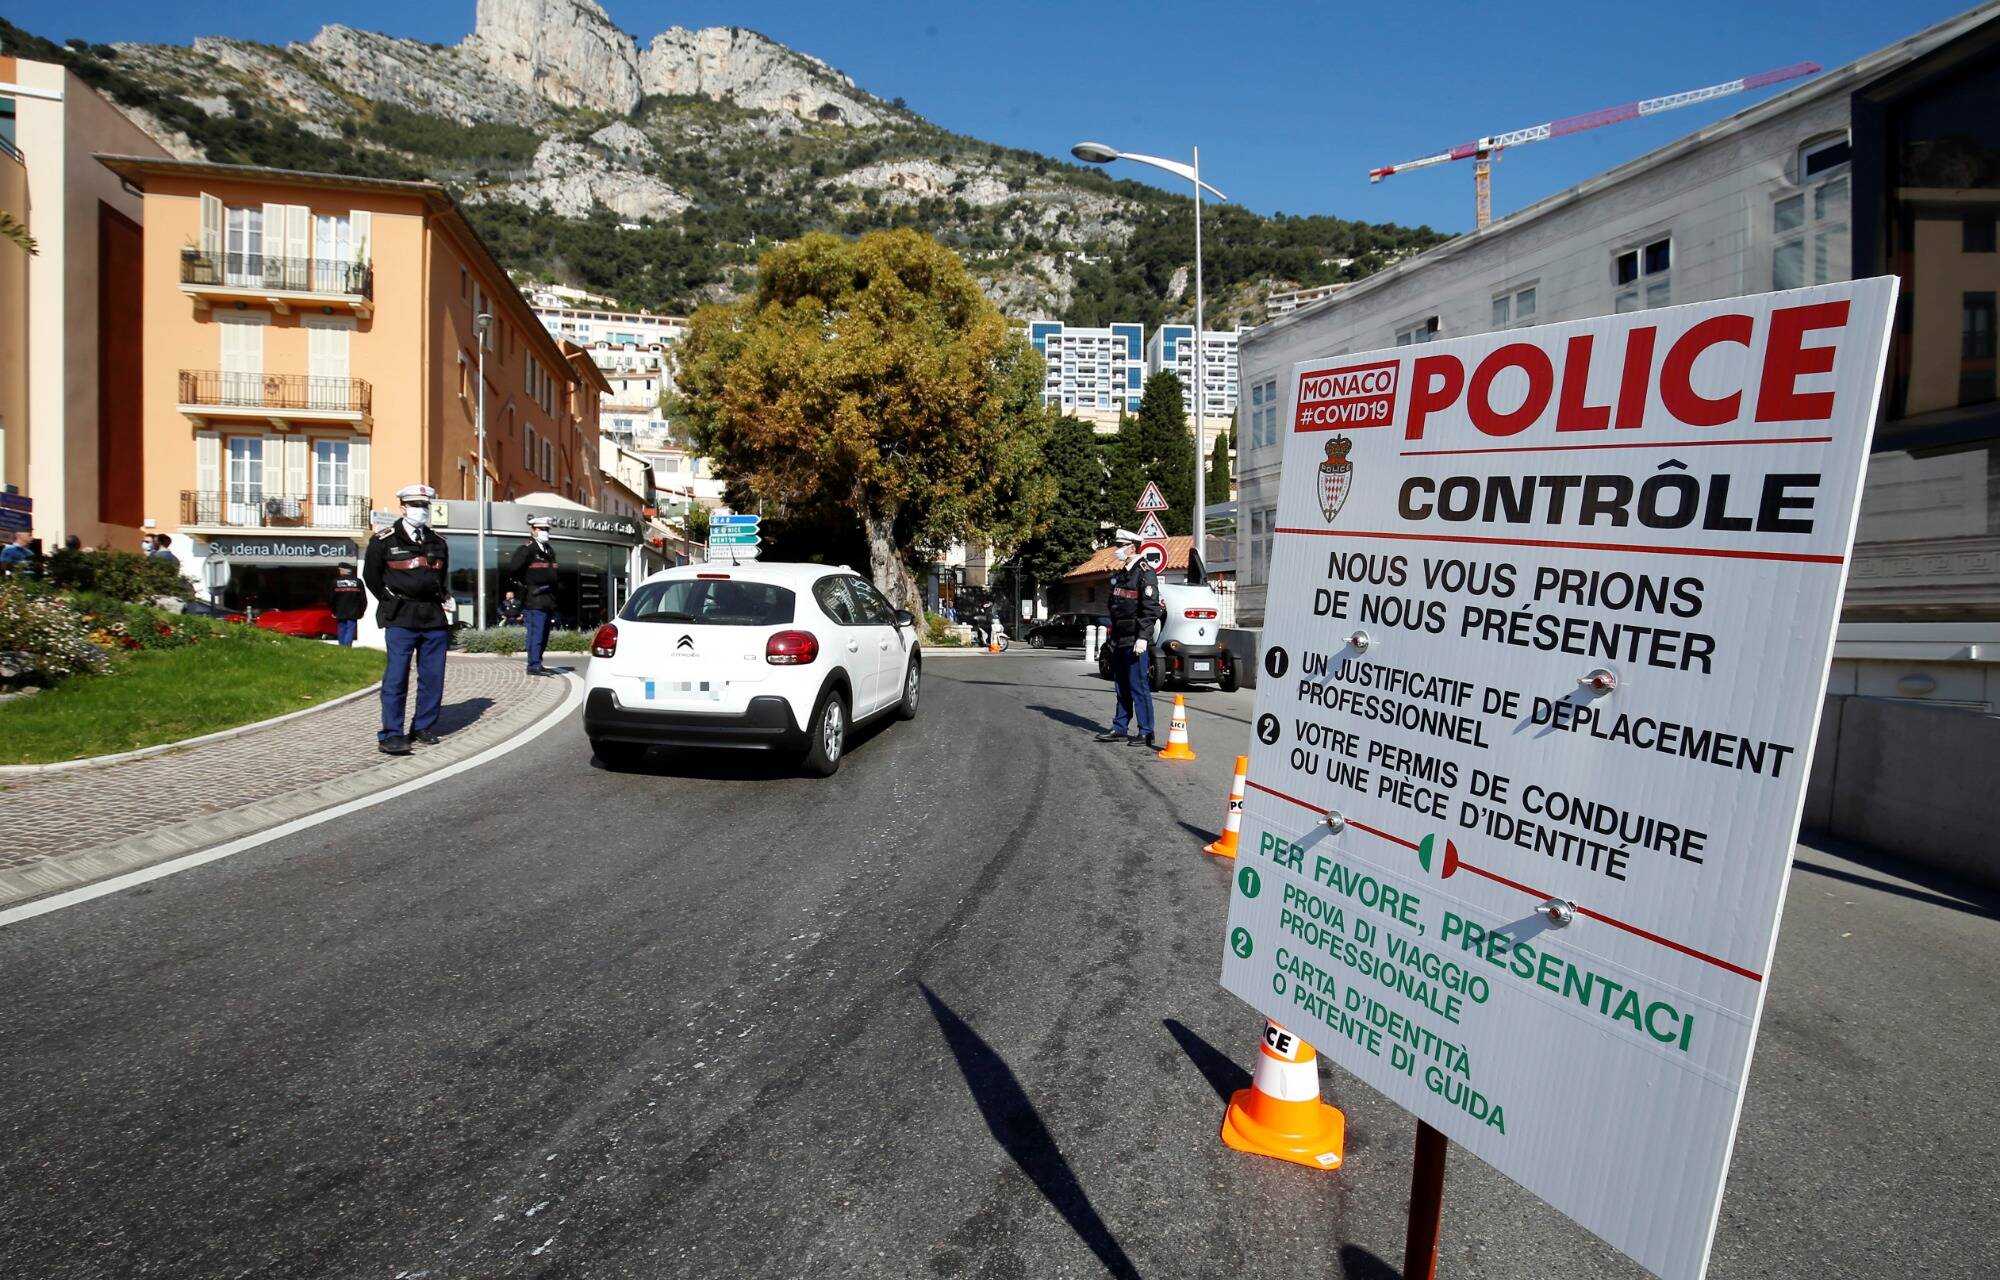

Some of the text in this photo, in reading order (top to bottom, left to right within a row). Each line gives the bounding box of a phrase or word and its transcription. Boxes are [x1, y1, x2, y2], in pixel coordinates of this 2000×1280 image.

[1300, 400, 1389, 426] #COVID19
[1304, 371, 1391, 400] MONACO
[1404, 300, 1850, 440] POLICE
[1320, 463, 1351, 474] POLICE
[1399, 458, 1821, 534] CONTRÔLE
[273, 543, 316, 556] Monte
[1328, 551, 1705, 619] NOUS VOUS PRIONS
[1313, 589, 1716, 675] DE NOUS PRÉSENTER
[1298, 679, 1490, 750] PROFESSIONNEL
[1302, 651, 1329, 678] UN
[1334, 657, 1475, 710] JUSTIFICATIF
[1482, 686, 1521, 720] DE
[1530, 694, 1795, 779] DÉPLACEMENT
[1290, 747, 1631, 882] OU UNE PIÈCE D'IDENTITÉ
[1295, 718, 1360, 759] VOTRE
[1368, 739, 1459, 789] PERMIS
[1469, 768, 1510, 805] DE
[1522, 784, 1708, 865] CONDUIRE
[1259, 831, 1694, 1053] PER FAVORE, PRESENTACI
[1279, 908, 1463, 1025] PROFESSIONALE
[1283, 882, 1345, 934] PROVA
[1353, 918, 1377, 949] DI
[1386, 932, 1490, 1004] VIAGGIO
[1272, 972, 1505, 1136] O PATENTE DI GUIDA
[1275, 947, 1336, 1001] CARTA
[1344, 986, 1471, 1081] D'IDENTITÀ
